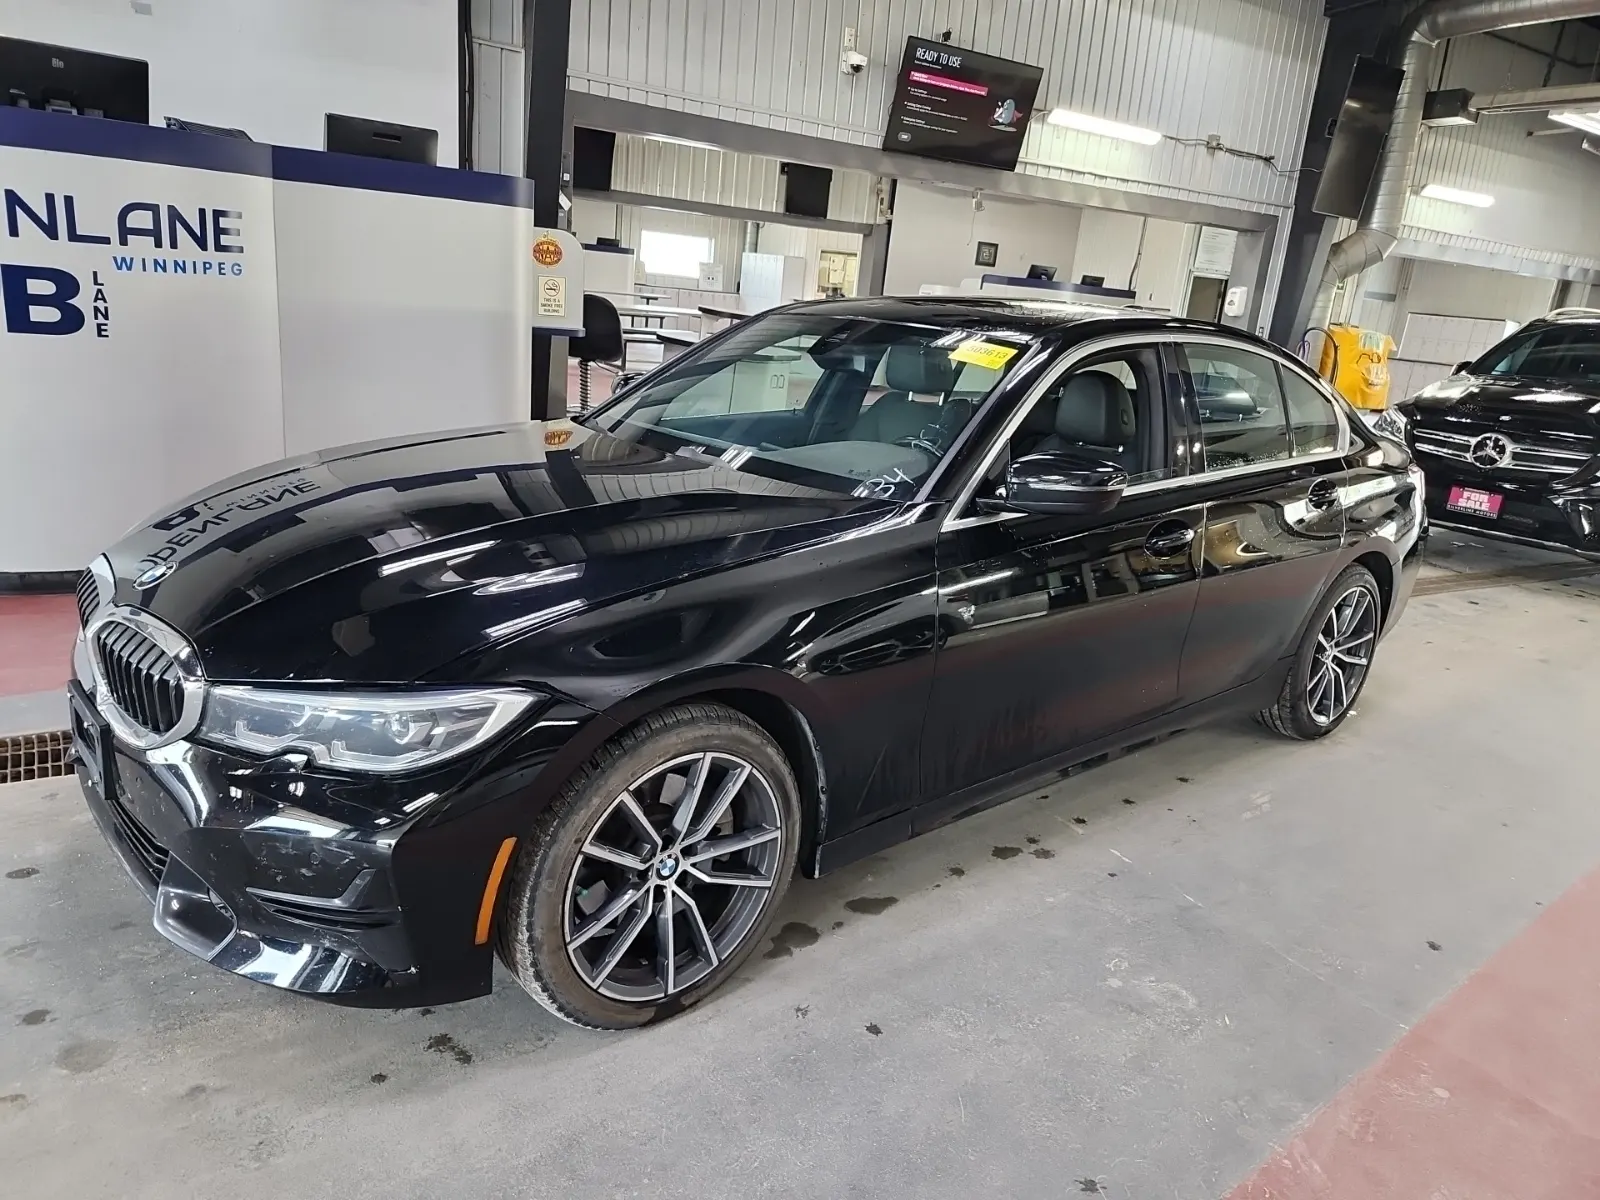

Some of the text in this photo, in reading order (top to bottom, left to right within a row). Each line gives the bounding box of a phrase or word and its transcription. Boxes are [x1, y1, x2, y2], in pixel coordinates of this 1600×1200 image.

[916, 48, 938, 62] READY
[940, 53, 948, 64] TO
[948, 56, 962, 68] USE
[4, 188, 244, 253] NLANE
[112, 256, 243, 276] WINNIPEG
[0, 263, 110, 338] B LANE
[1458, 498, 1490, 511] SALE
[1462, 491, 1489, 502] FOR
